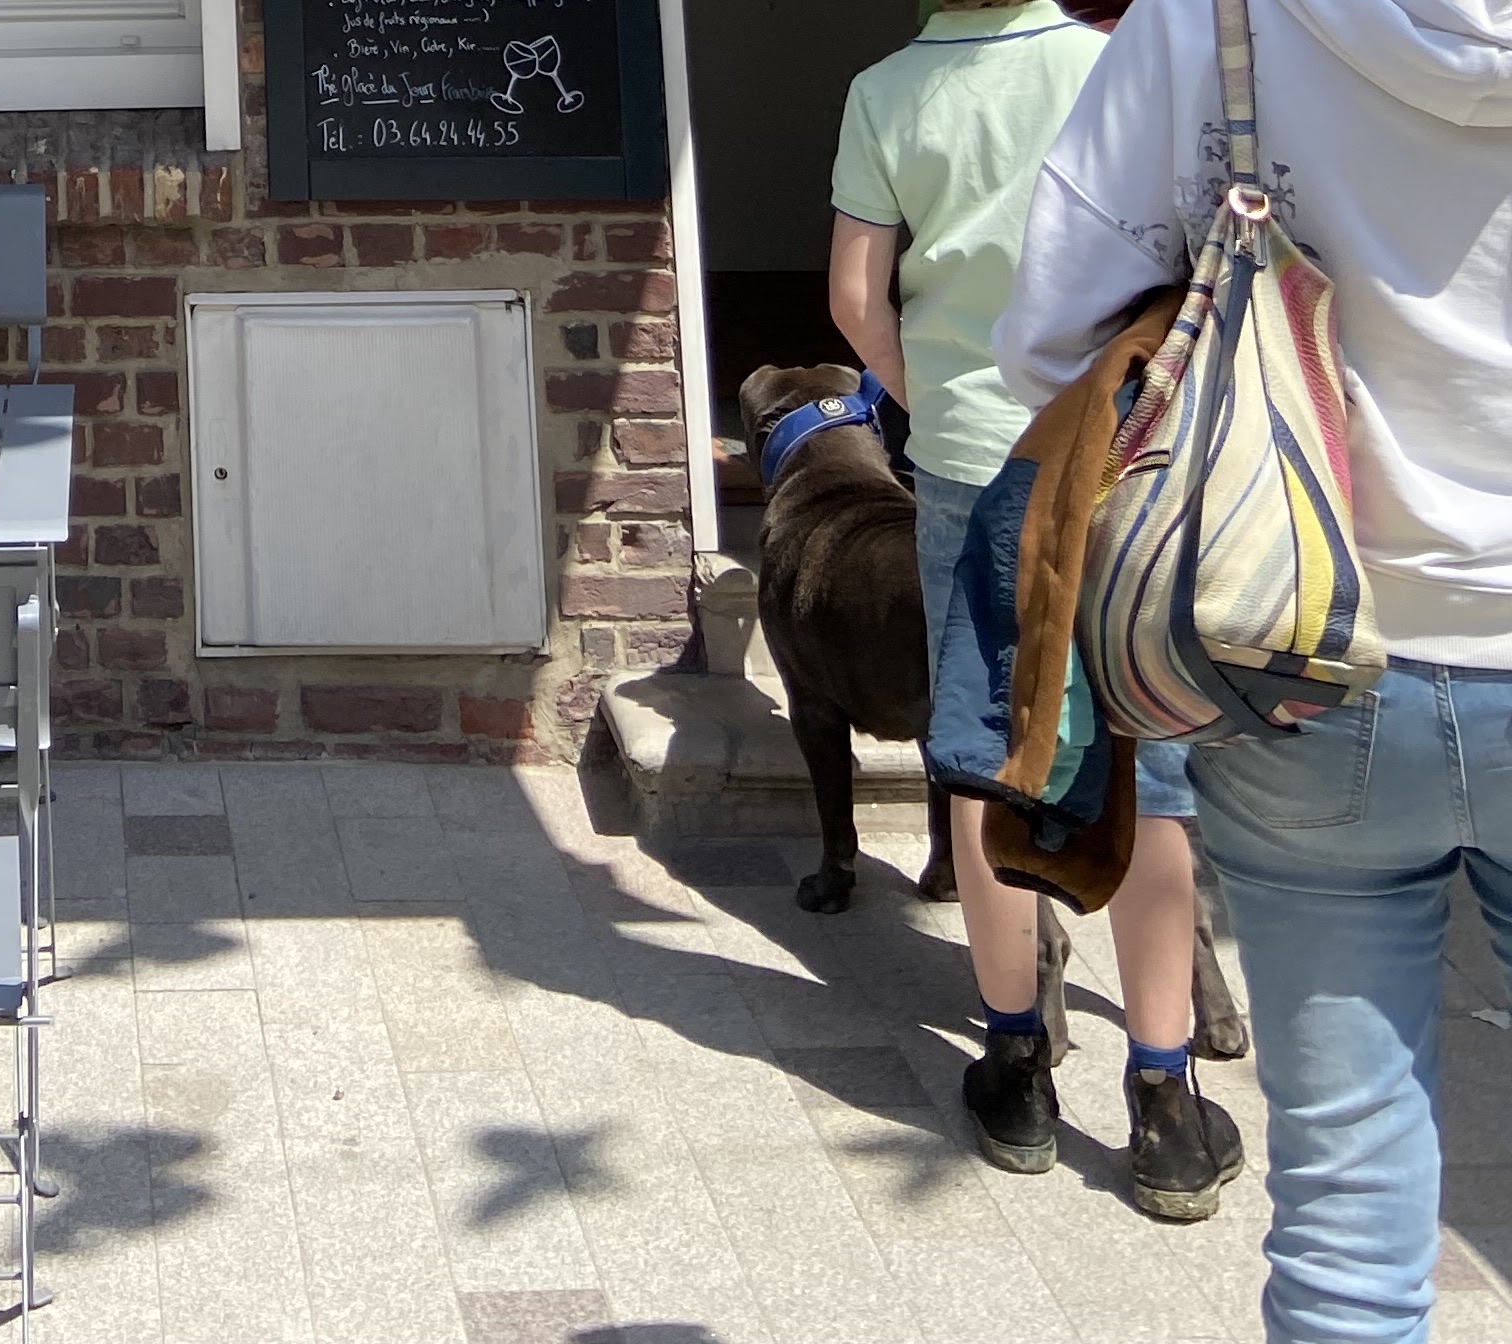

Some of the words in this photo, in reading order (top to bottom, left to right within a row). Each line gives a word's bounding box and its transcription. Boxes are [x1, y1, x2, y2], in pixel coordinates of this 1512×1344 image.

[310, 64, 339, 96] Thé
[379, 74, 398, 96] du
[398, 71, 438, 107] Jour
[372, 117, 521, 148] 03.64.24.44.55
